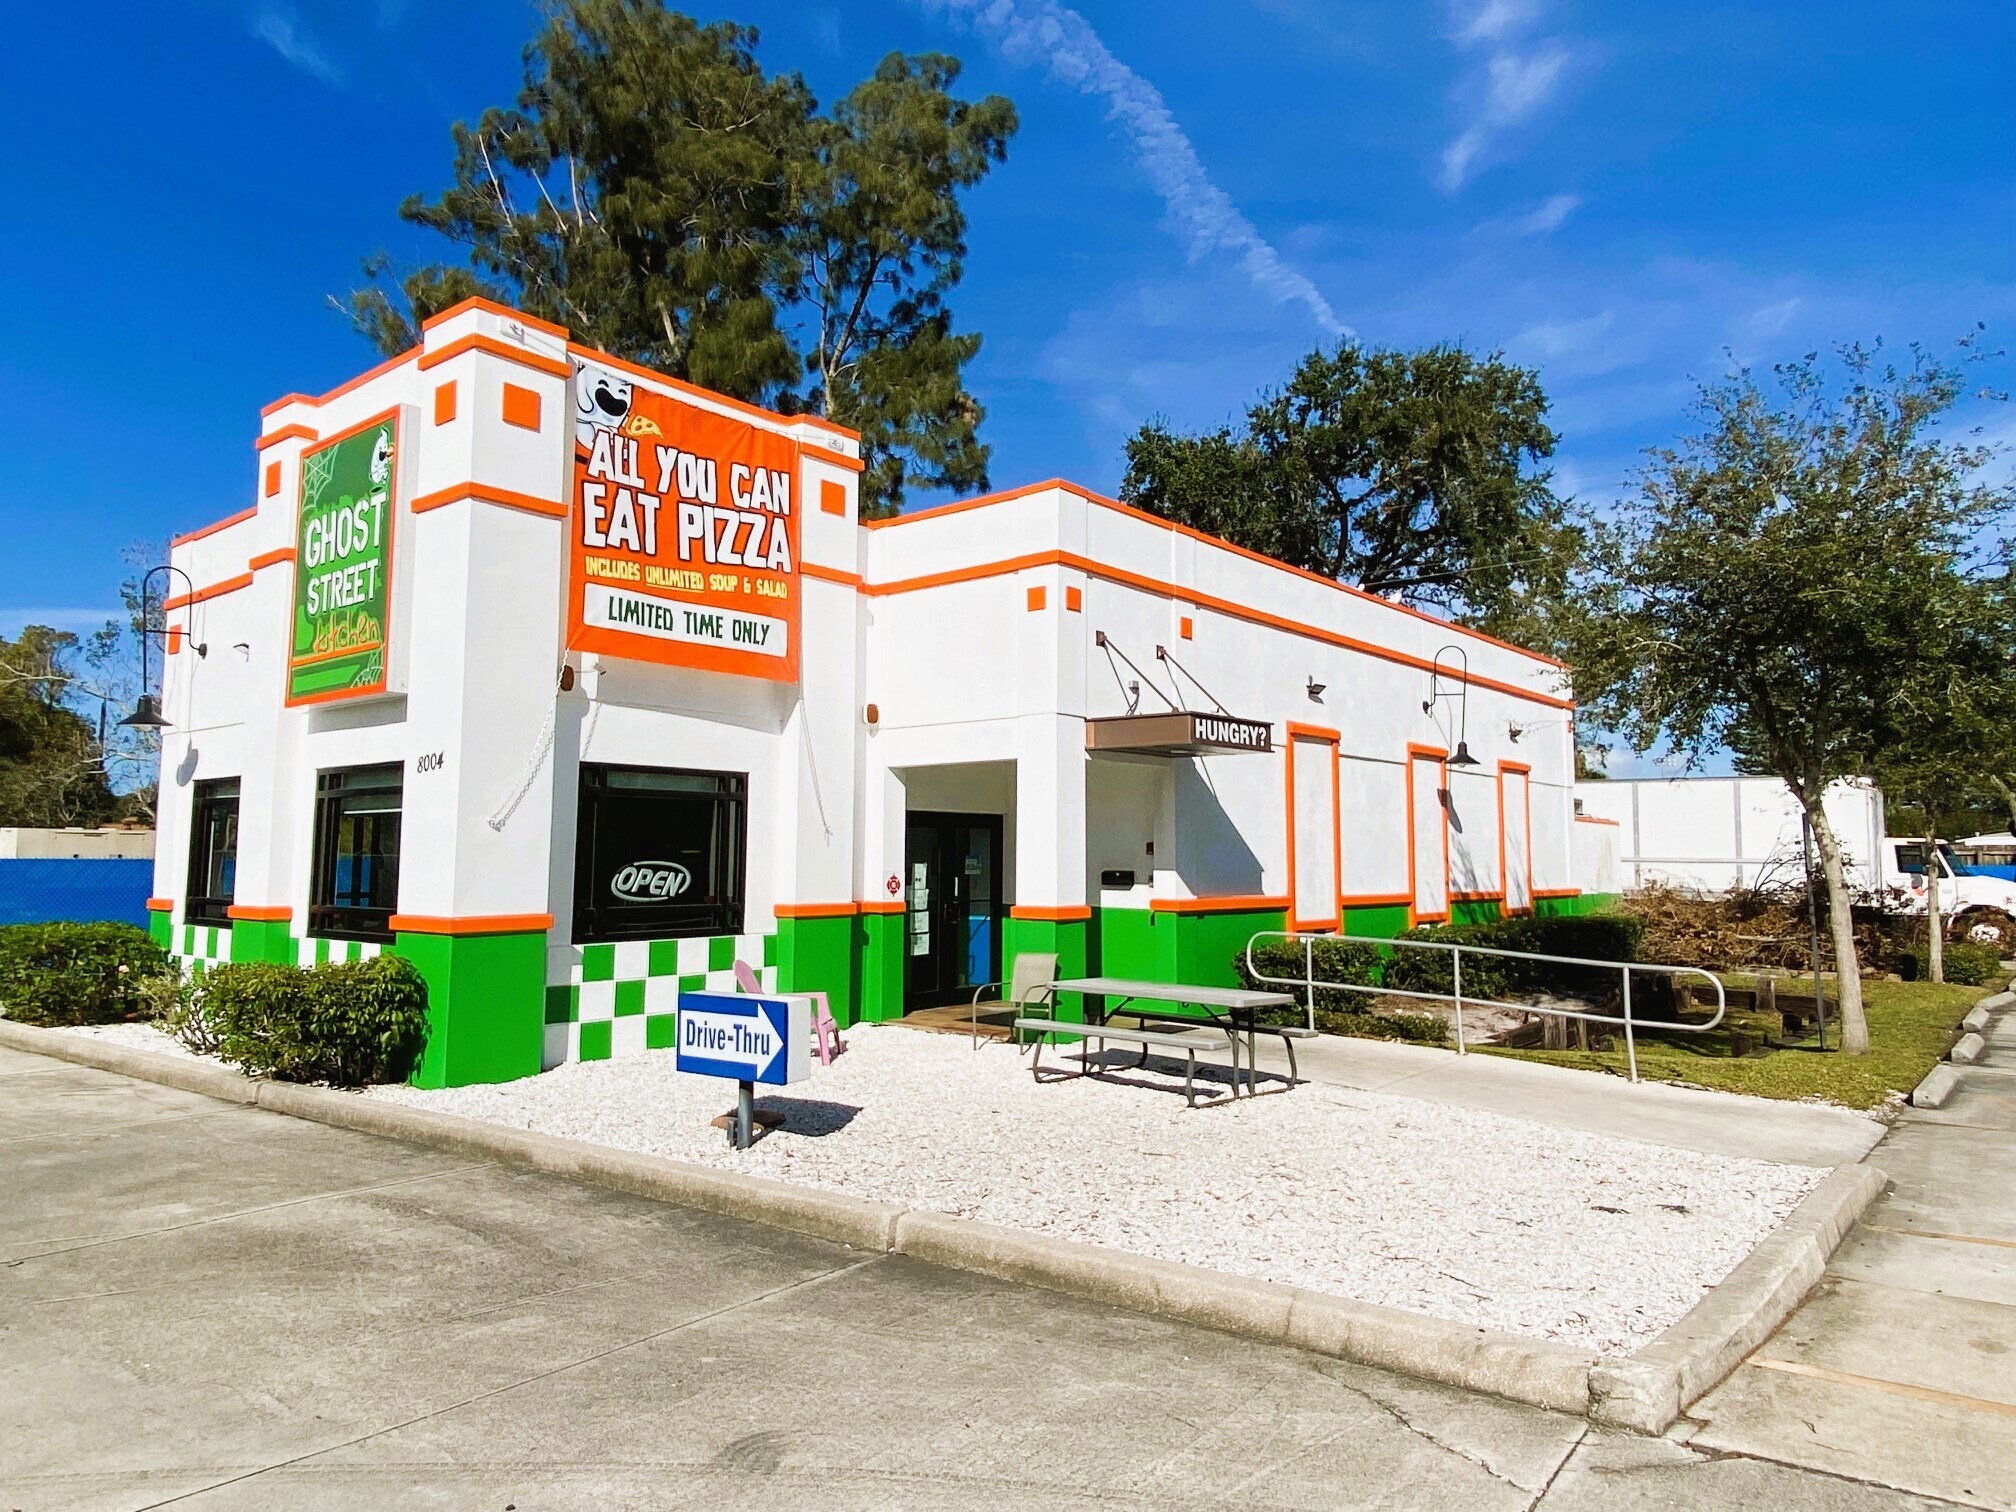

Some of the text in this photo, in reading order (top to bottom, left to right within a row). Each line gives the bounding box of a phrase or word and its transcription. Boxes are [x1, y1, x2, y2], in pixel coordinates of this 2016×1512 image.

[586, 429, 791, 515] ALL YOU CAN
[305, 492, 387, 568] GHOST
[582, 481, 792, 573] EAT PIZZA
[306, 558, 379, 615] STREET
[585, 556, 788, 599] INCLUDES UNLIMITED SOUP & SALAD
[313, 611, 380, 653] kitchen
[608, 596, 770, 645] LIMITED TIME ONLY
[1195, 718, 1267, 746] HUNGRY?
[417, 751, 444, 773] 8004
[616, 866, 684, 897] OPEN
[686, 1018, 770, 1056] Drive-Thru
